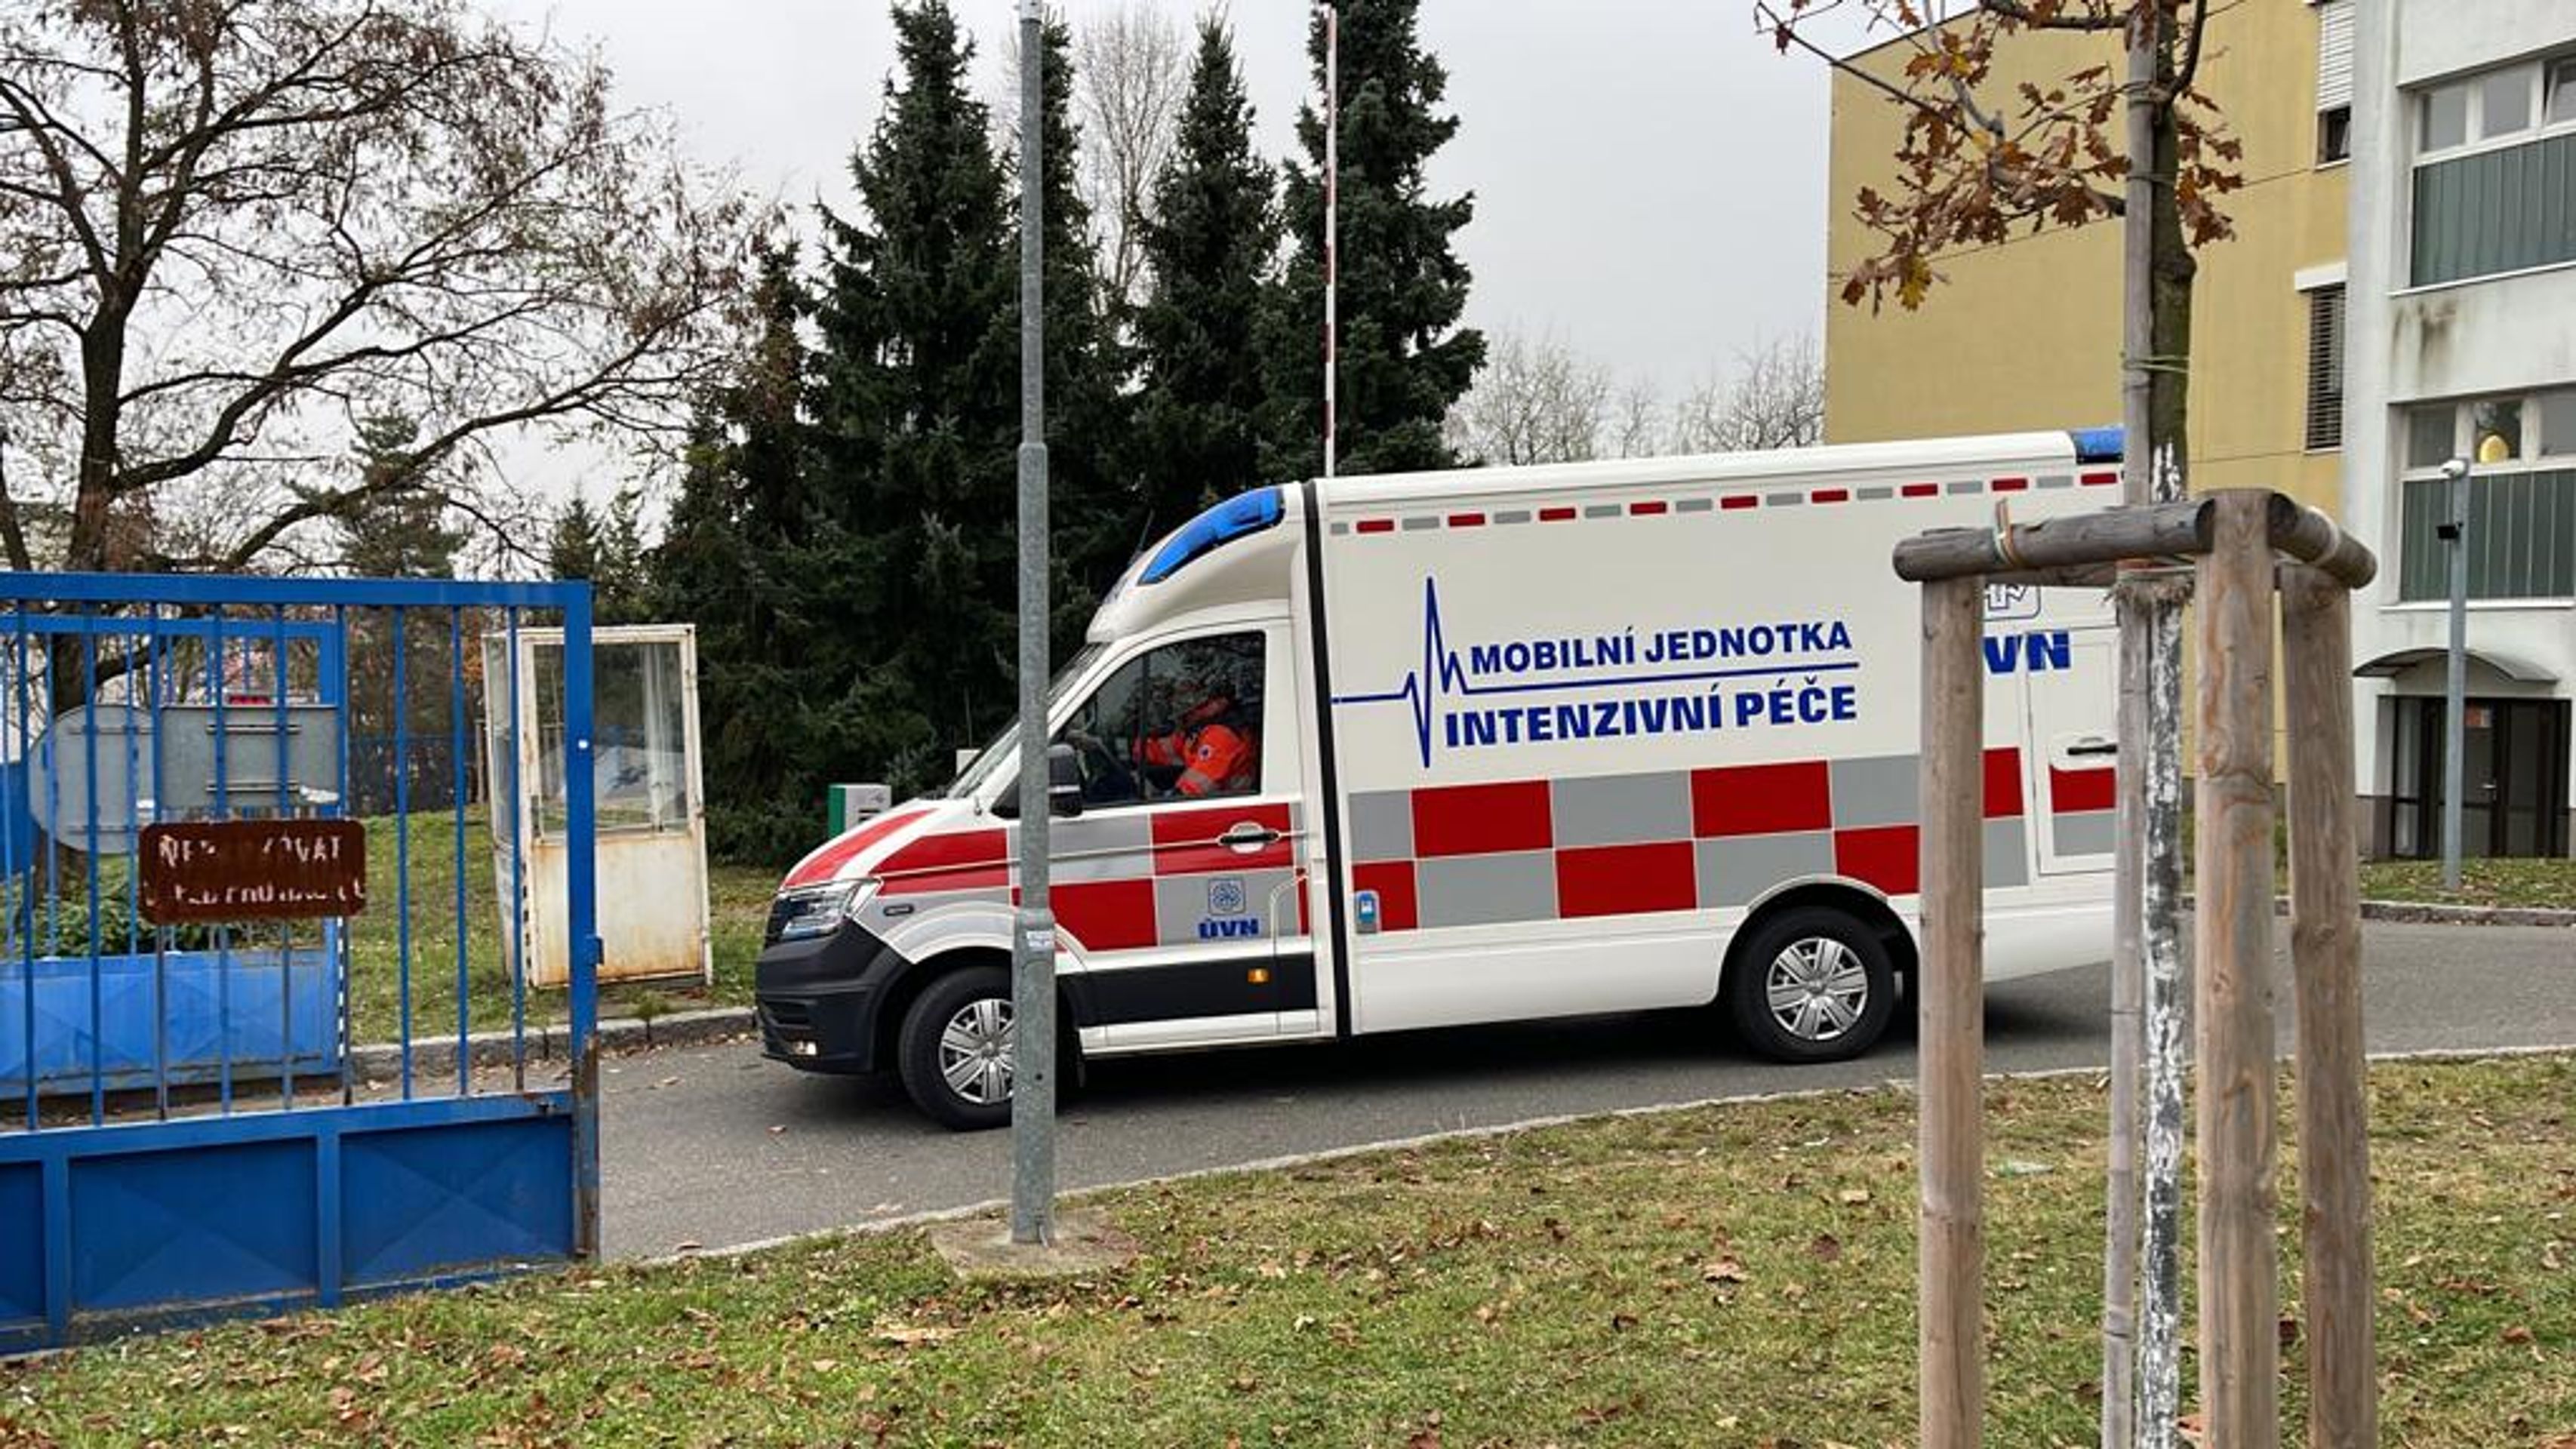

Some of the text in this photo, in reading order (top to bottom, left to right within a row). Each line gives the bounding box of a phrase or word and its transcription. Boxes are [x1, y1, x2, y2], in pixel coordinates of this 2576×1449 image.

[1470, 623, 1852, 675] MOBILNÍ JEDNOTKA
[1983, 629, 2072, 675] VN
[1445, 675, 1854, 747] INTENZIVNÍ PÉČE
[1197, 918, 1260, 939] ÚVN
